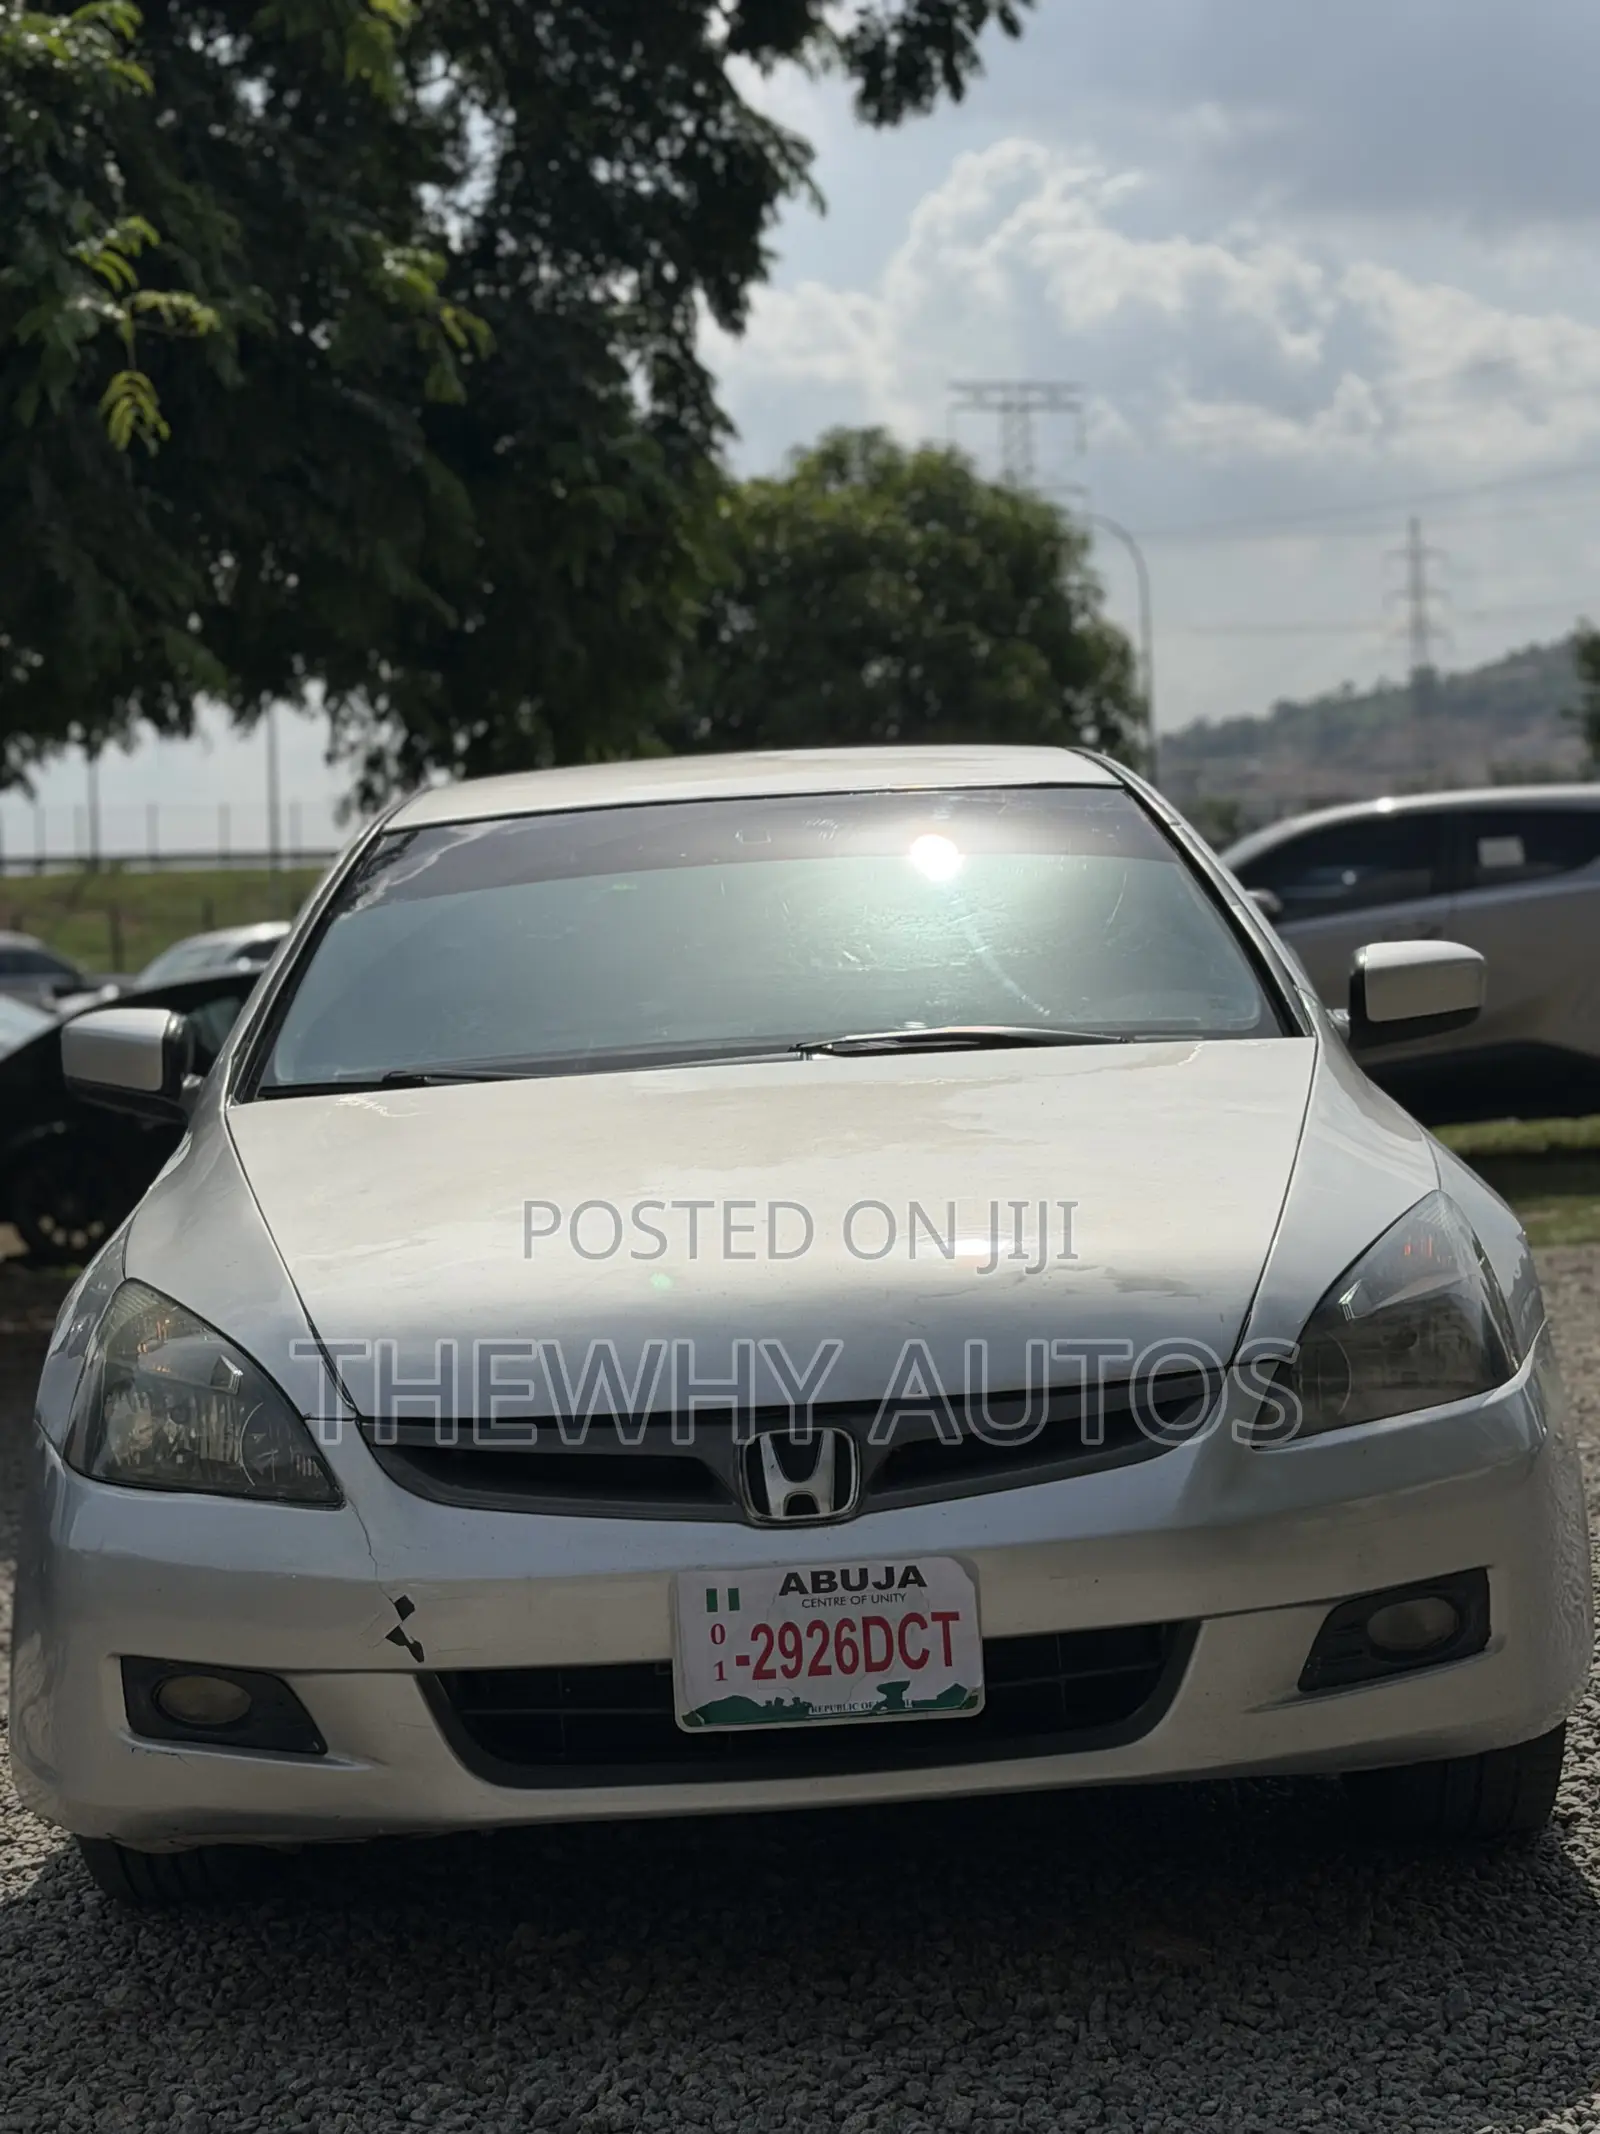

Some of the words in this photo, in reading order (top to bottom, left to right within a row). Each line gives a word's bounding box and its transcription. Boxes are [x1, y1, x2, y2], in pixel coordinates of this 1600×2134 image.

[778, 1565, 928, 1597] ABUJA
[801, 1596, 846, 1609] CENTRE
[850, 1594, 868, 1606] OF
[871, 1592, 907, 1604] UNITY
[811, 1702, 859, 1714] REPUBLIC
